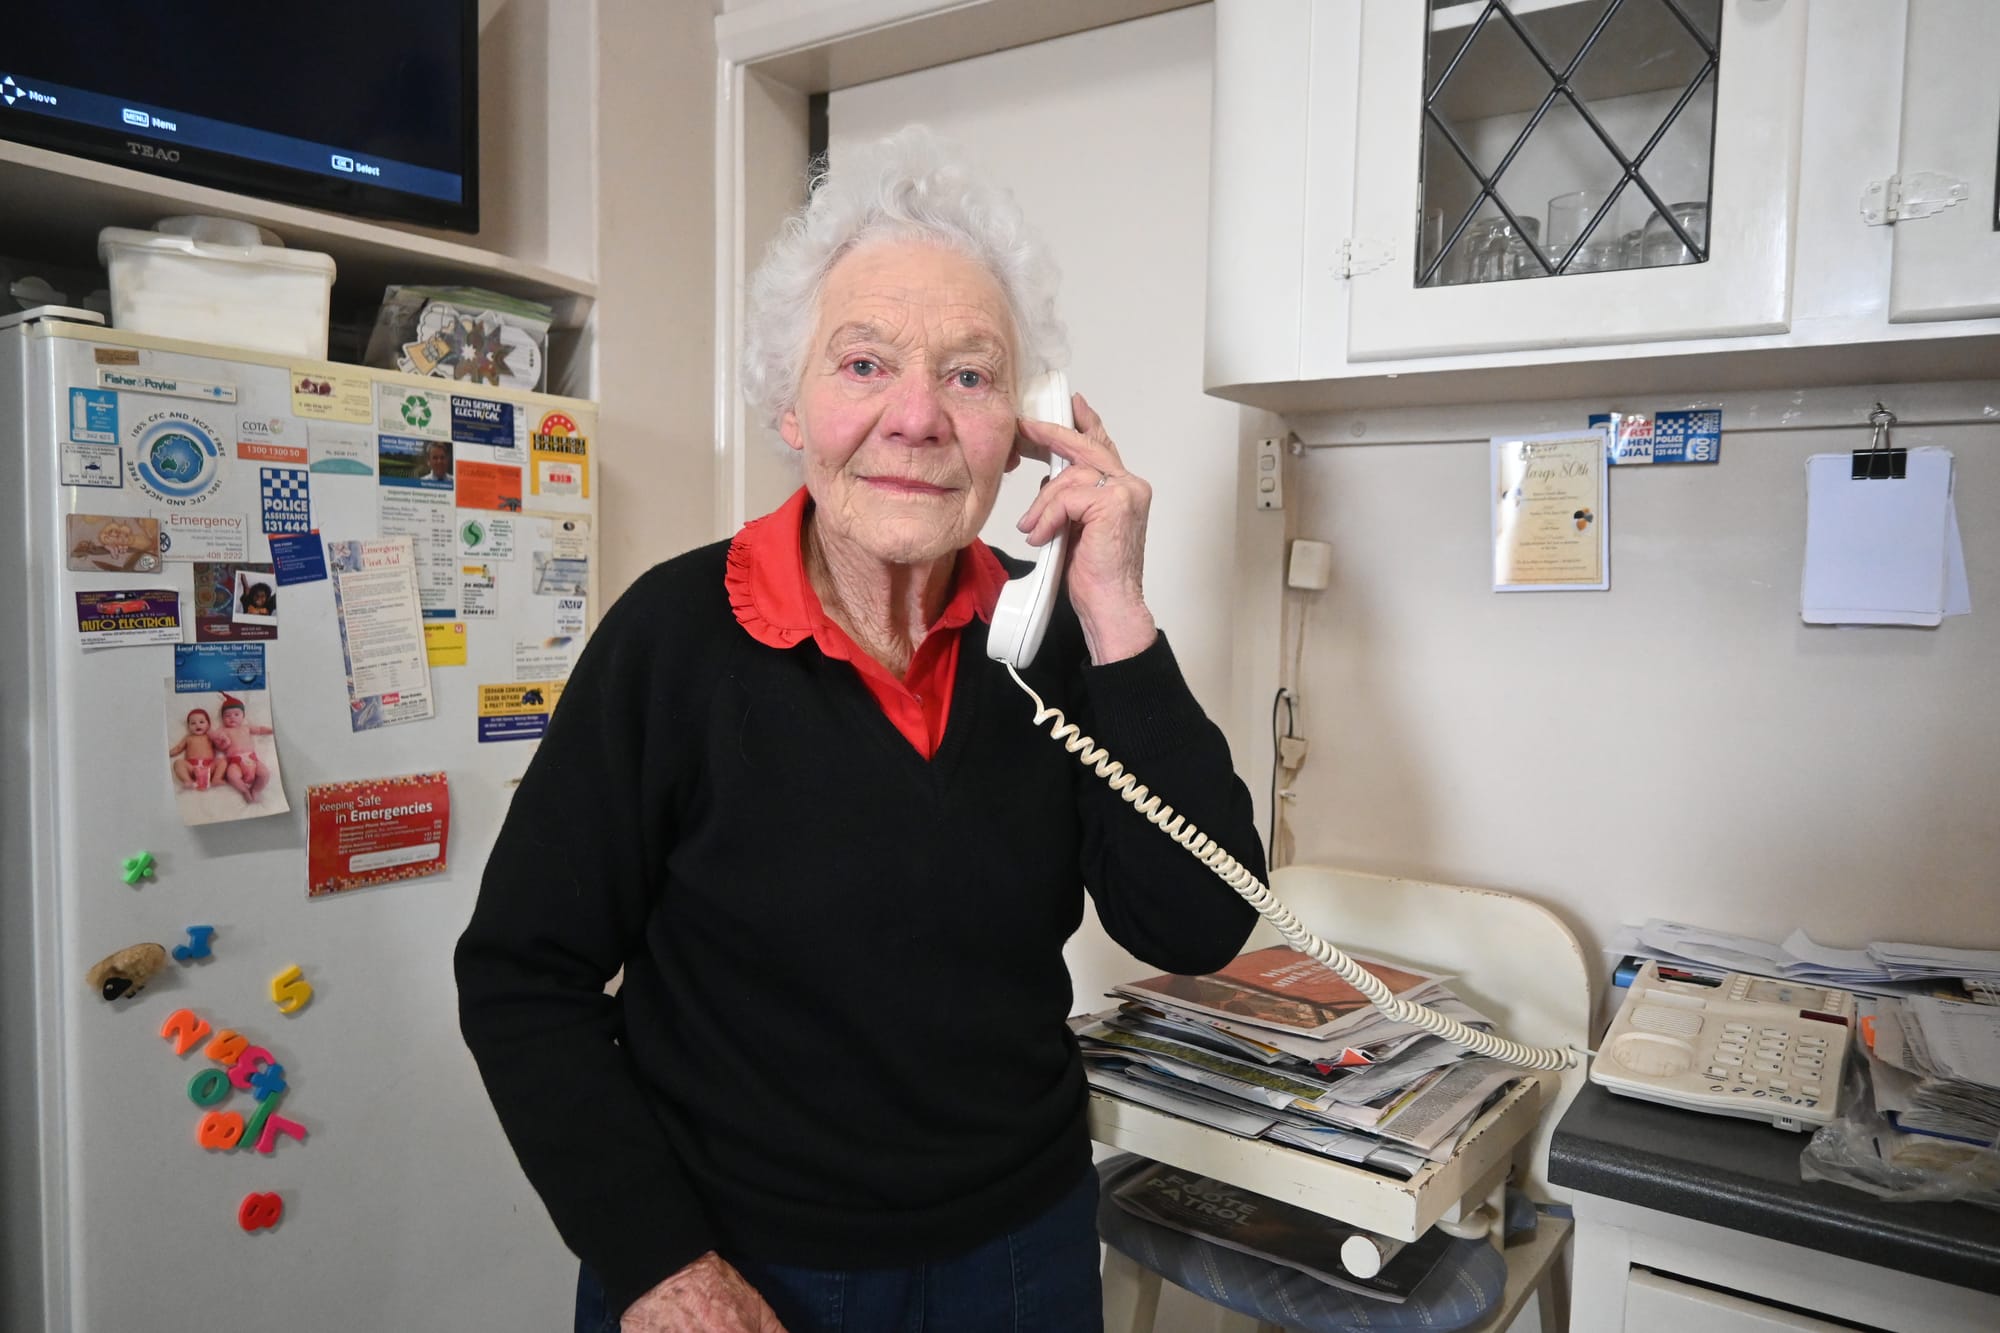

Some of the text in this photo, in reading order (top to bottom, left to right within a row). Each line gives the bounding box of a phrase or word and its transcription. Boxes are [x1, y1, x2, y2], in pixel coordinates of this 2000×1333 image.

[29, 89, 57, 105] Move
[152, 116, 177, 132] Menu
[127, 142, 181, 164] TEAC
[356, 162, 381, 177] Select
[105, 373, 136, 386] Fisher
[144, 378, 177, 391] Paykel
[452, 397, 502, 413] GLEN SEMPLE
[148, 412, 165, 422] CFC
[169, 411, 189, 420] AND
[192, 417, 214, 435] HCFC
[214, 437, 226, 457] FREE
[242, 420, 269, 433] COTA
[1619, 428, 1653, 437] FRST
[1621, 438, 1652, 446] HEN
[1655, 435, 1684, 443] POLICE
[247, 445, 300, 457] 1300 1300 50
[1619, 447, 1652, 457] DIAL
[1695, 437, 1710, 461] 000
[166, 498, 186, 506] AND
[263, 498, 308, 512] POLICE
[170, 513, 242, 529] Emergency
[264, 511, 308, 521] ASSISTANCE
[385, 554, 401, 565] Aid
[81, 615, 178, 632] AUTO ELECTRICAL
[319, 794, 382, 813] Keeping Safe
[336, 802, 433, 824] in Emergencies
[270, 965, 313, 1014] 5
[160, 1008, 212, 1056] 2
[197, 1110, 244, 1150] 8
[1146, 1178, 1251, 1227] PATROL
[1165, 1175, 1258, 1215] FOOTE
[238, 1192, 283, 1232] 8
